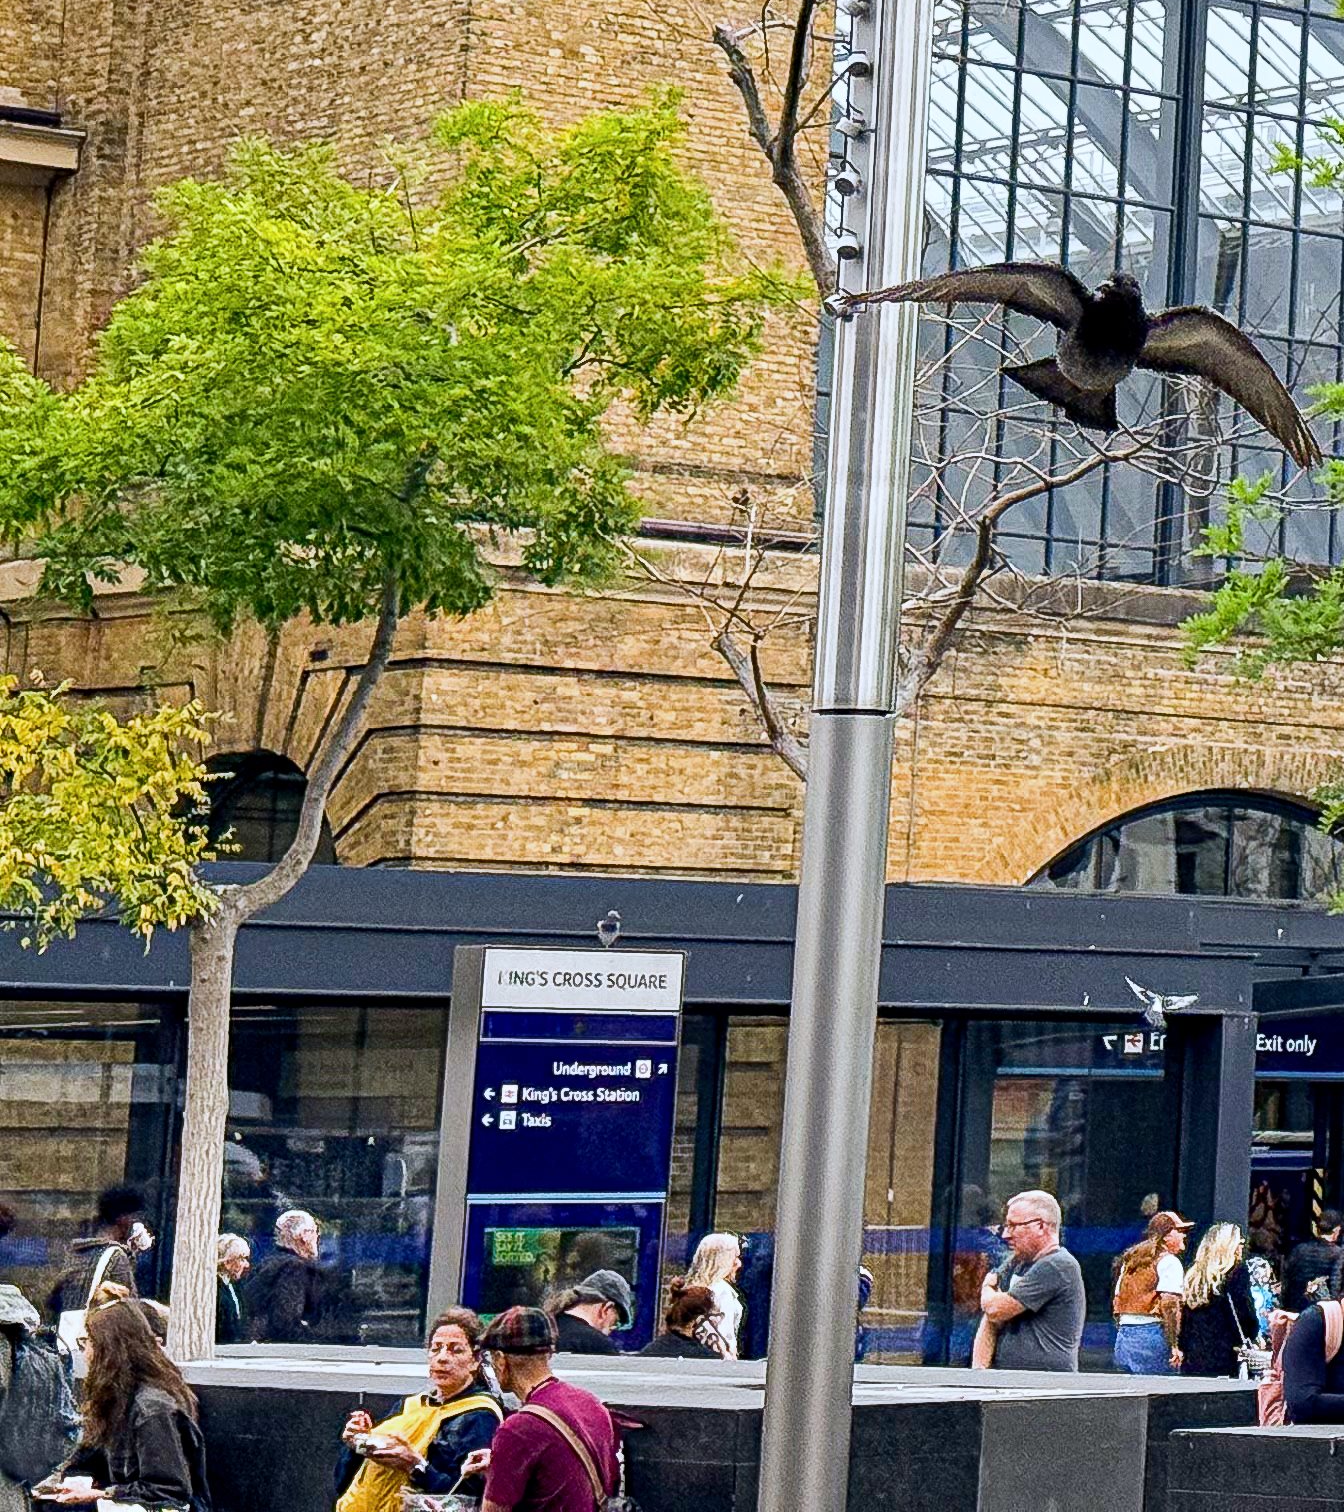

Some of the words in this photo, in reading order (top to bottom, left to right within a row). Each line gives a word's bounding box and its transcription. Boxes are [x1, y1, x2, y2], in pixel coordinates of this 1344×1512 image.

[552, 971, 603, 989] CROSS
[606, 973, 668, 991] SQUARE
[1255, 1033, 1284, 1052] Exit
[1286, 1034, 1318, 1057] only
[553, 1062, 632, 1079] Underground
[522, 1086, 558, 1105] King's
[560, 1087, 594, 1102] Cross
[596, 1087, 640, 1102] Station
[522, 1113, 552, 1128] Taxis
